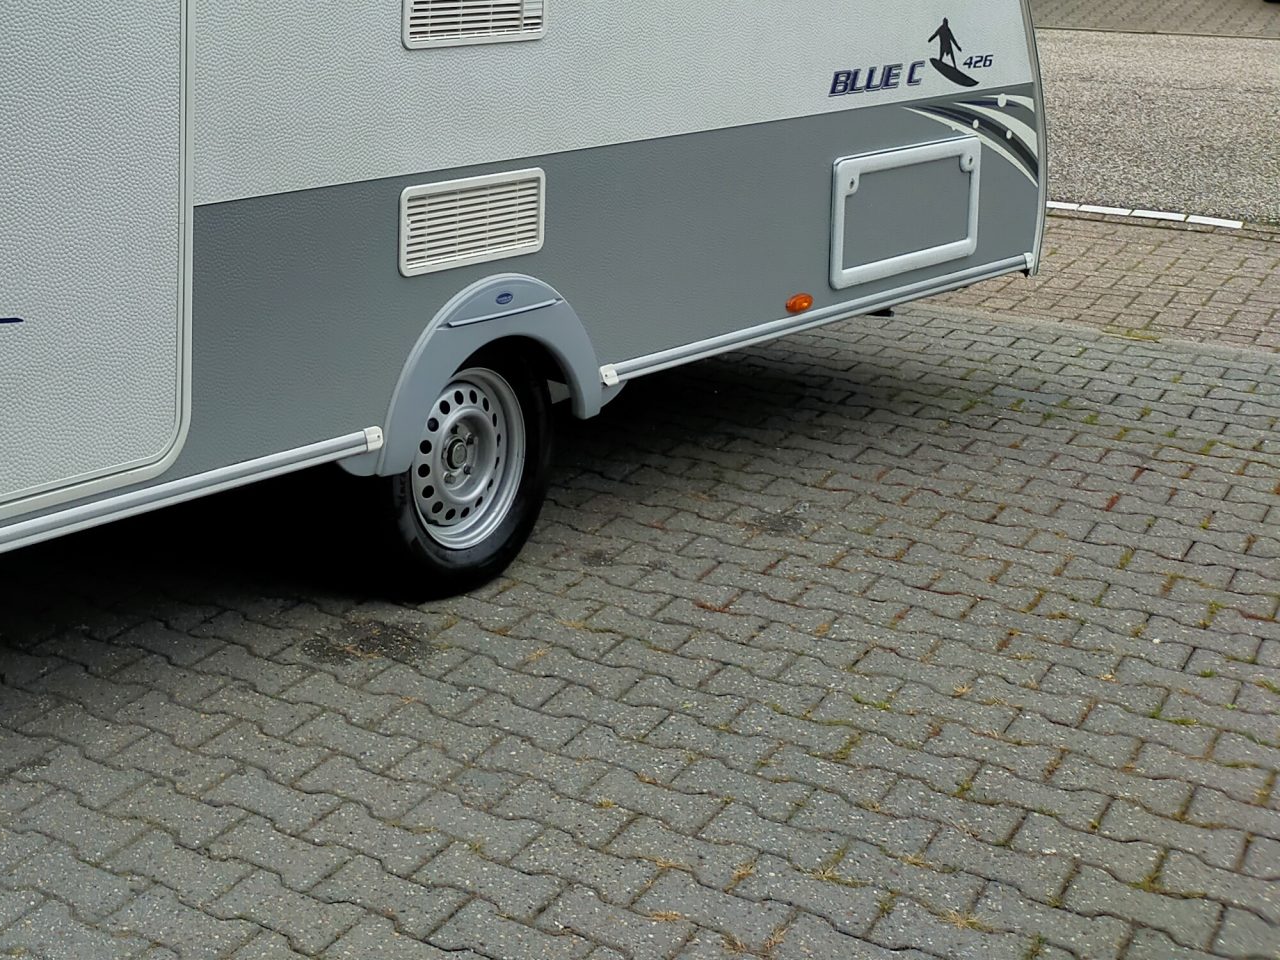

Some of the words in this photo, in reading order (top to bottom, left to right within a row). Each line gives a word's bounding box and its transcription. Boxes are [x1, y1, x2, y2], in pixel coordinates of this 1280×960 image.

[962, 54, 994, 70] 426
[828, 62, 904, 98] BLUE
[906, 60, 925, 87] C
